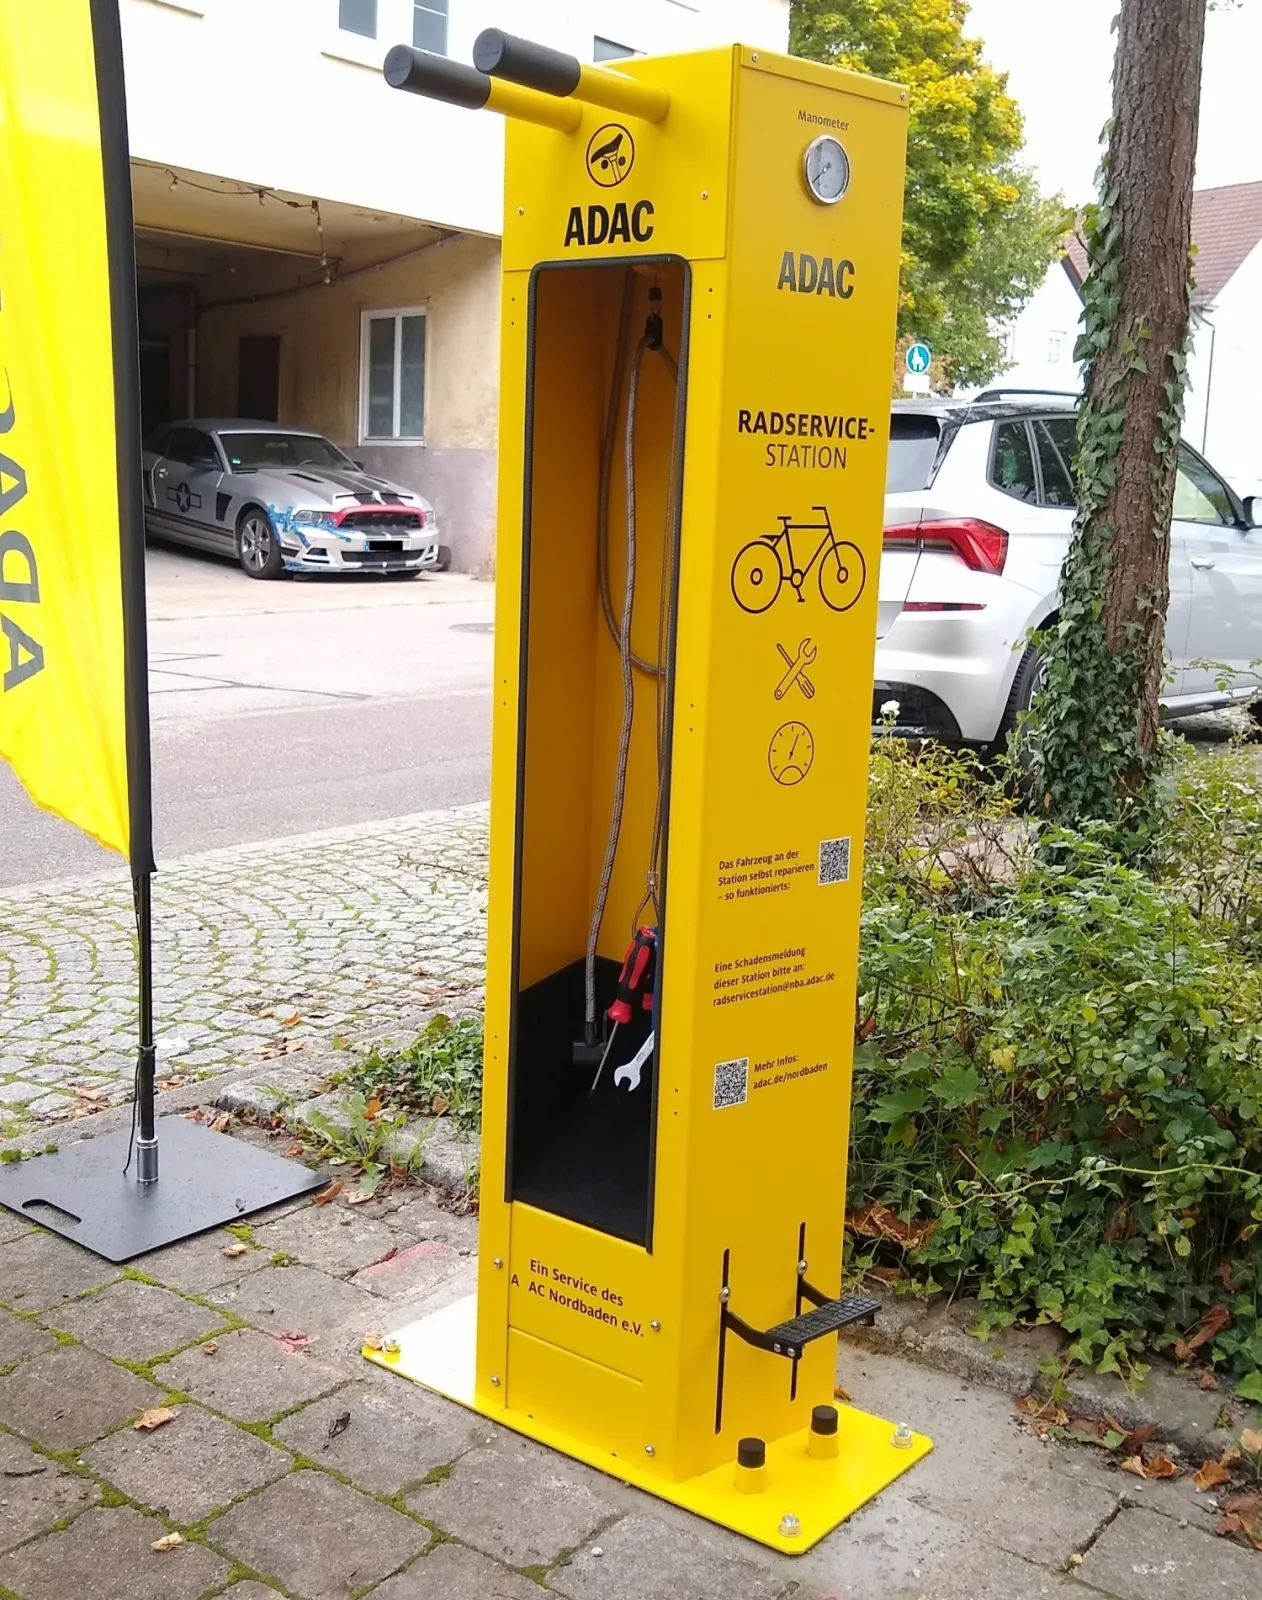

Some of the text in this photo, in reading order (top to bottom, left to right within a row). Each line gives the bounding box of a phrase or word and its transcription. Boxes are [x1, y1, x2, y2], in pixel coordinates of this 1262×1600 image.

[798, 110, 849, 131] Manometer
[564, 200, 654, 247] ADAC
[777, 251, 855, 299] ADAC
[739, 409, 875, 440] RADSERVICE-
[765, 443, 847, 469] STATION
[719, 850, 799, 870] Das Fahrzeug an der
[718, 862, 814, 886] Station selbst reparieren
[725, 891, 734, 900] so
[736, 881, 790, 898] funktionierts:
[715, 947, 806, 973] Eine Schadensmeldung
[713, 971, 835, 1006] radservicestation@nba.adac.de
[714, 963, 805, 989] dieser Station bitte an:
[753, 1062, 828, 1089] adac.de/nordbaden
[754, 1055, 799, 1072] Mehr Infos:
[530, 1259, 624, 1306] Ein Service des
[549, 1288, 617, 1326] Nordbaden
[622, 1319, 644, 1337] e.V.
